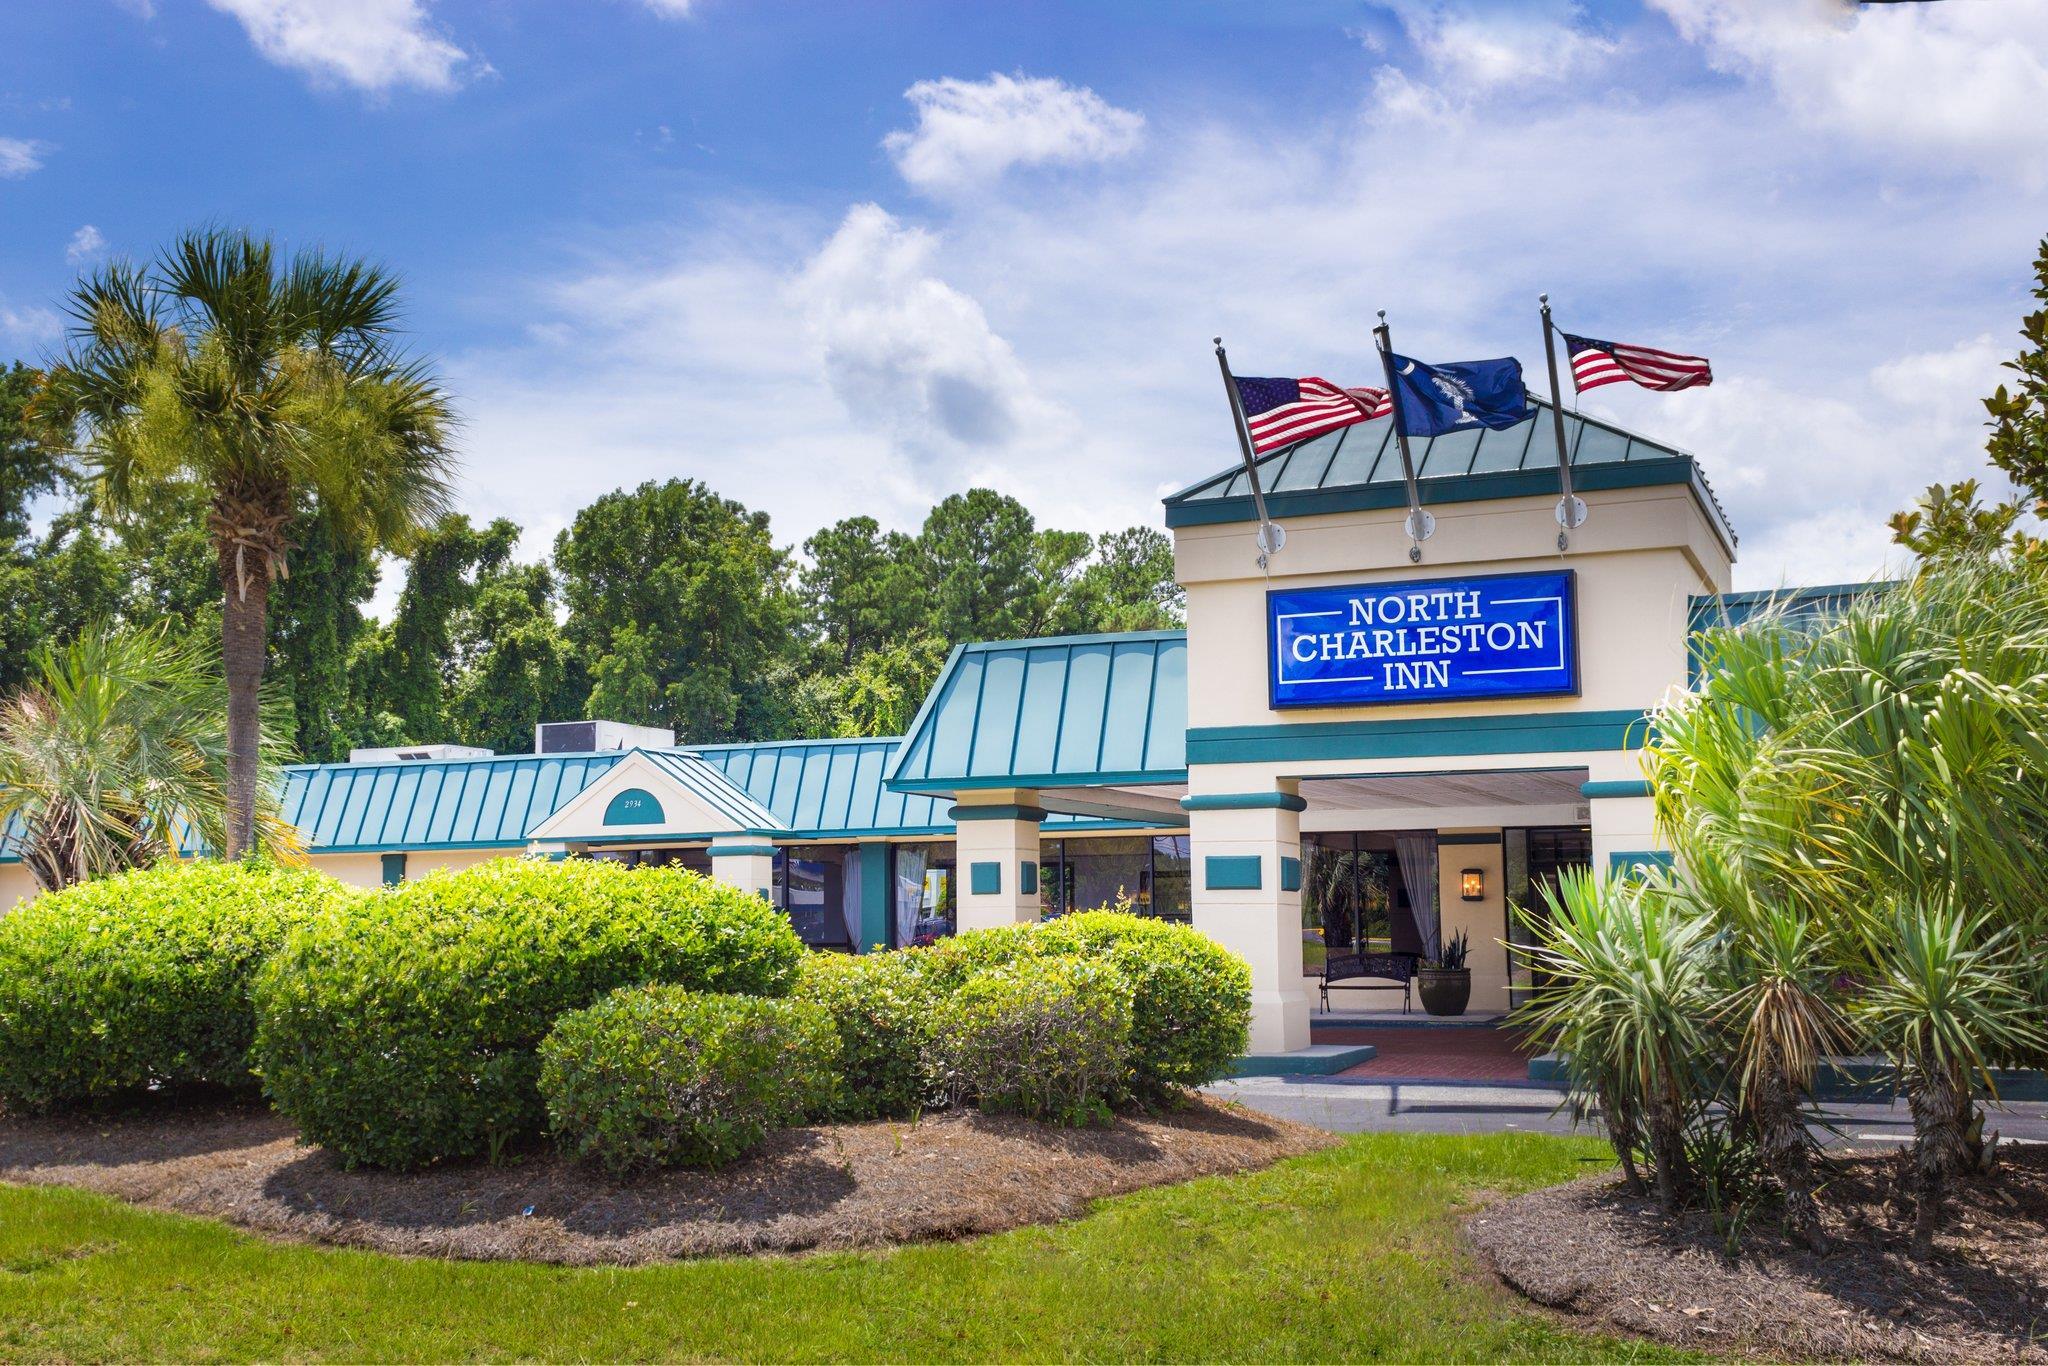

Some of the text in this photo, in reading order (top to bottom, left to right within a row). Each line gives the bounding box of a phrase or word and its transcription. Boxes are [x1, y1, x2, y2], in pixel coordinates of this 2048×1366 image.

[1349, 591, 1482, 626] NORTH
[1292, 620, 1547, 662] CHARLESTON
[1382, 659, 1451, 690] INN
[624, 800, 642, 808] 2934
